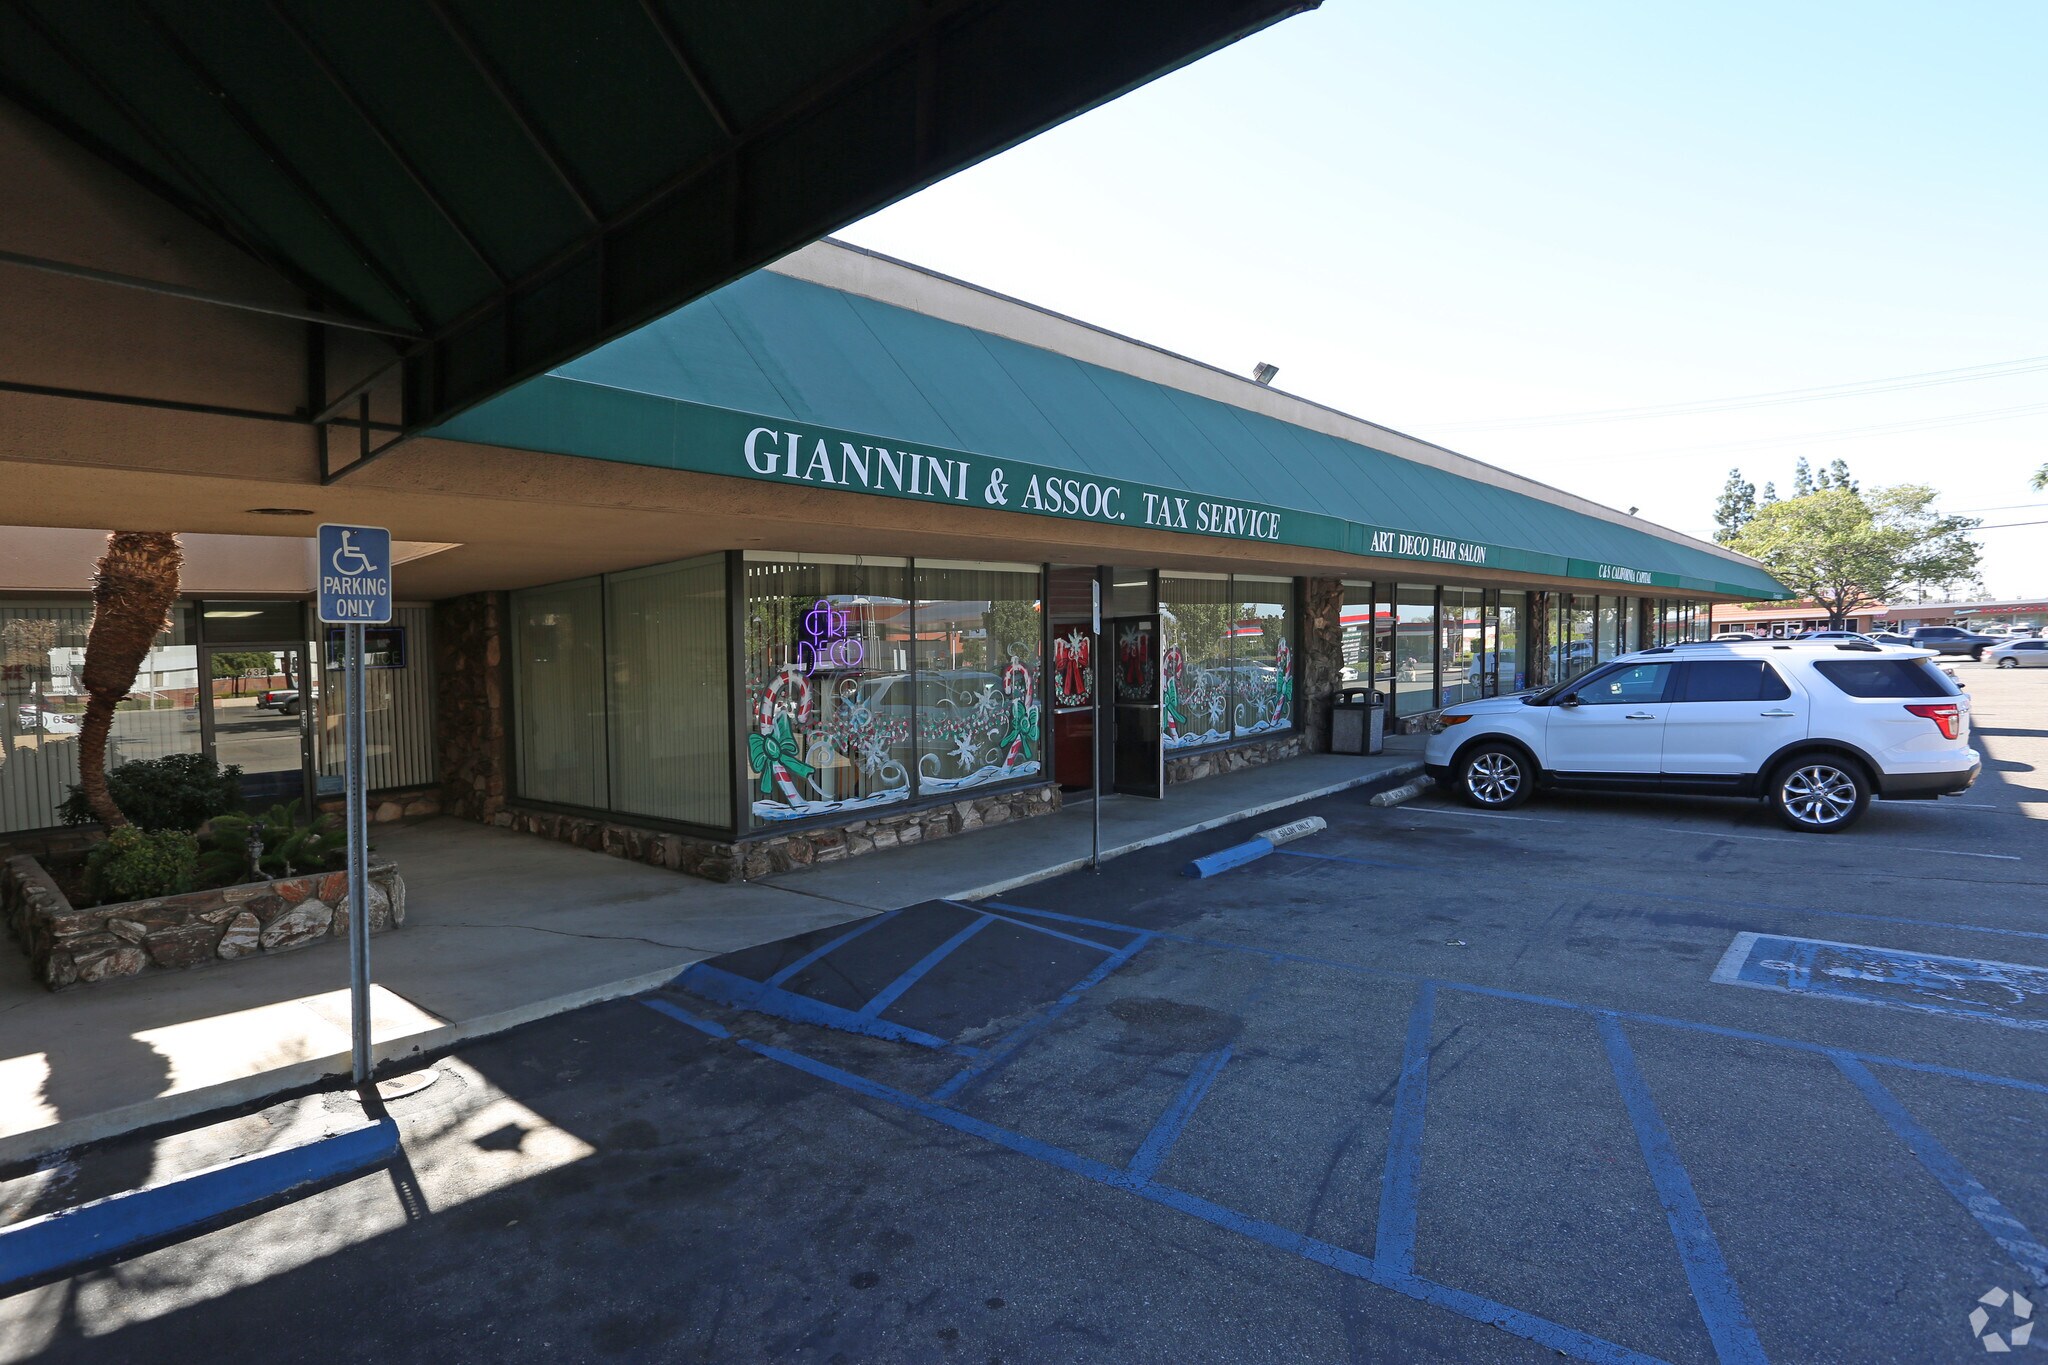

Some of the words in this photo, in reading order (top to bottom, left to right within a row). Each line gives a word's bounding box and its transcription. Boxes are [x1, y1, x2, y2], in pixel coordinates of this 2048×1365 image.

[744, 427, 970, 500] GIANNINI
[984, 467, 1008, 506] &
[1021, 474, 1126, 521] ASSOC.
[1143, 492, 1189, 529] TAX
[1196, 501, 1281, 540] SERVICE
[1370, 531, 1395, 553] ART
[1398, 534, 1429, 557] DECO
[1432, 538, 1456, 560] HAIR
[1458, 543, 1487, 563] SALON
[324, 576, 387, 596] PARKING
[336, 598, 375, 617] ONLY
[805, 599, 851, 646] ART
[246, 668, 266, 676] 632
[797, 639, 864, 678] DECO
[1295, 820, 1311, 831] ONLY
